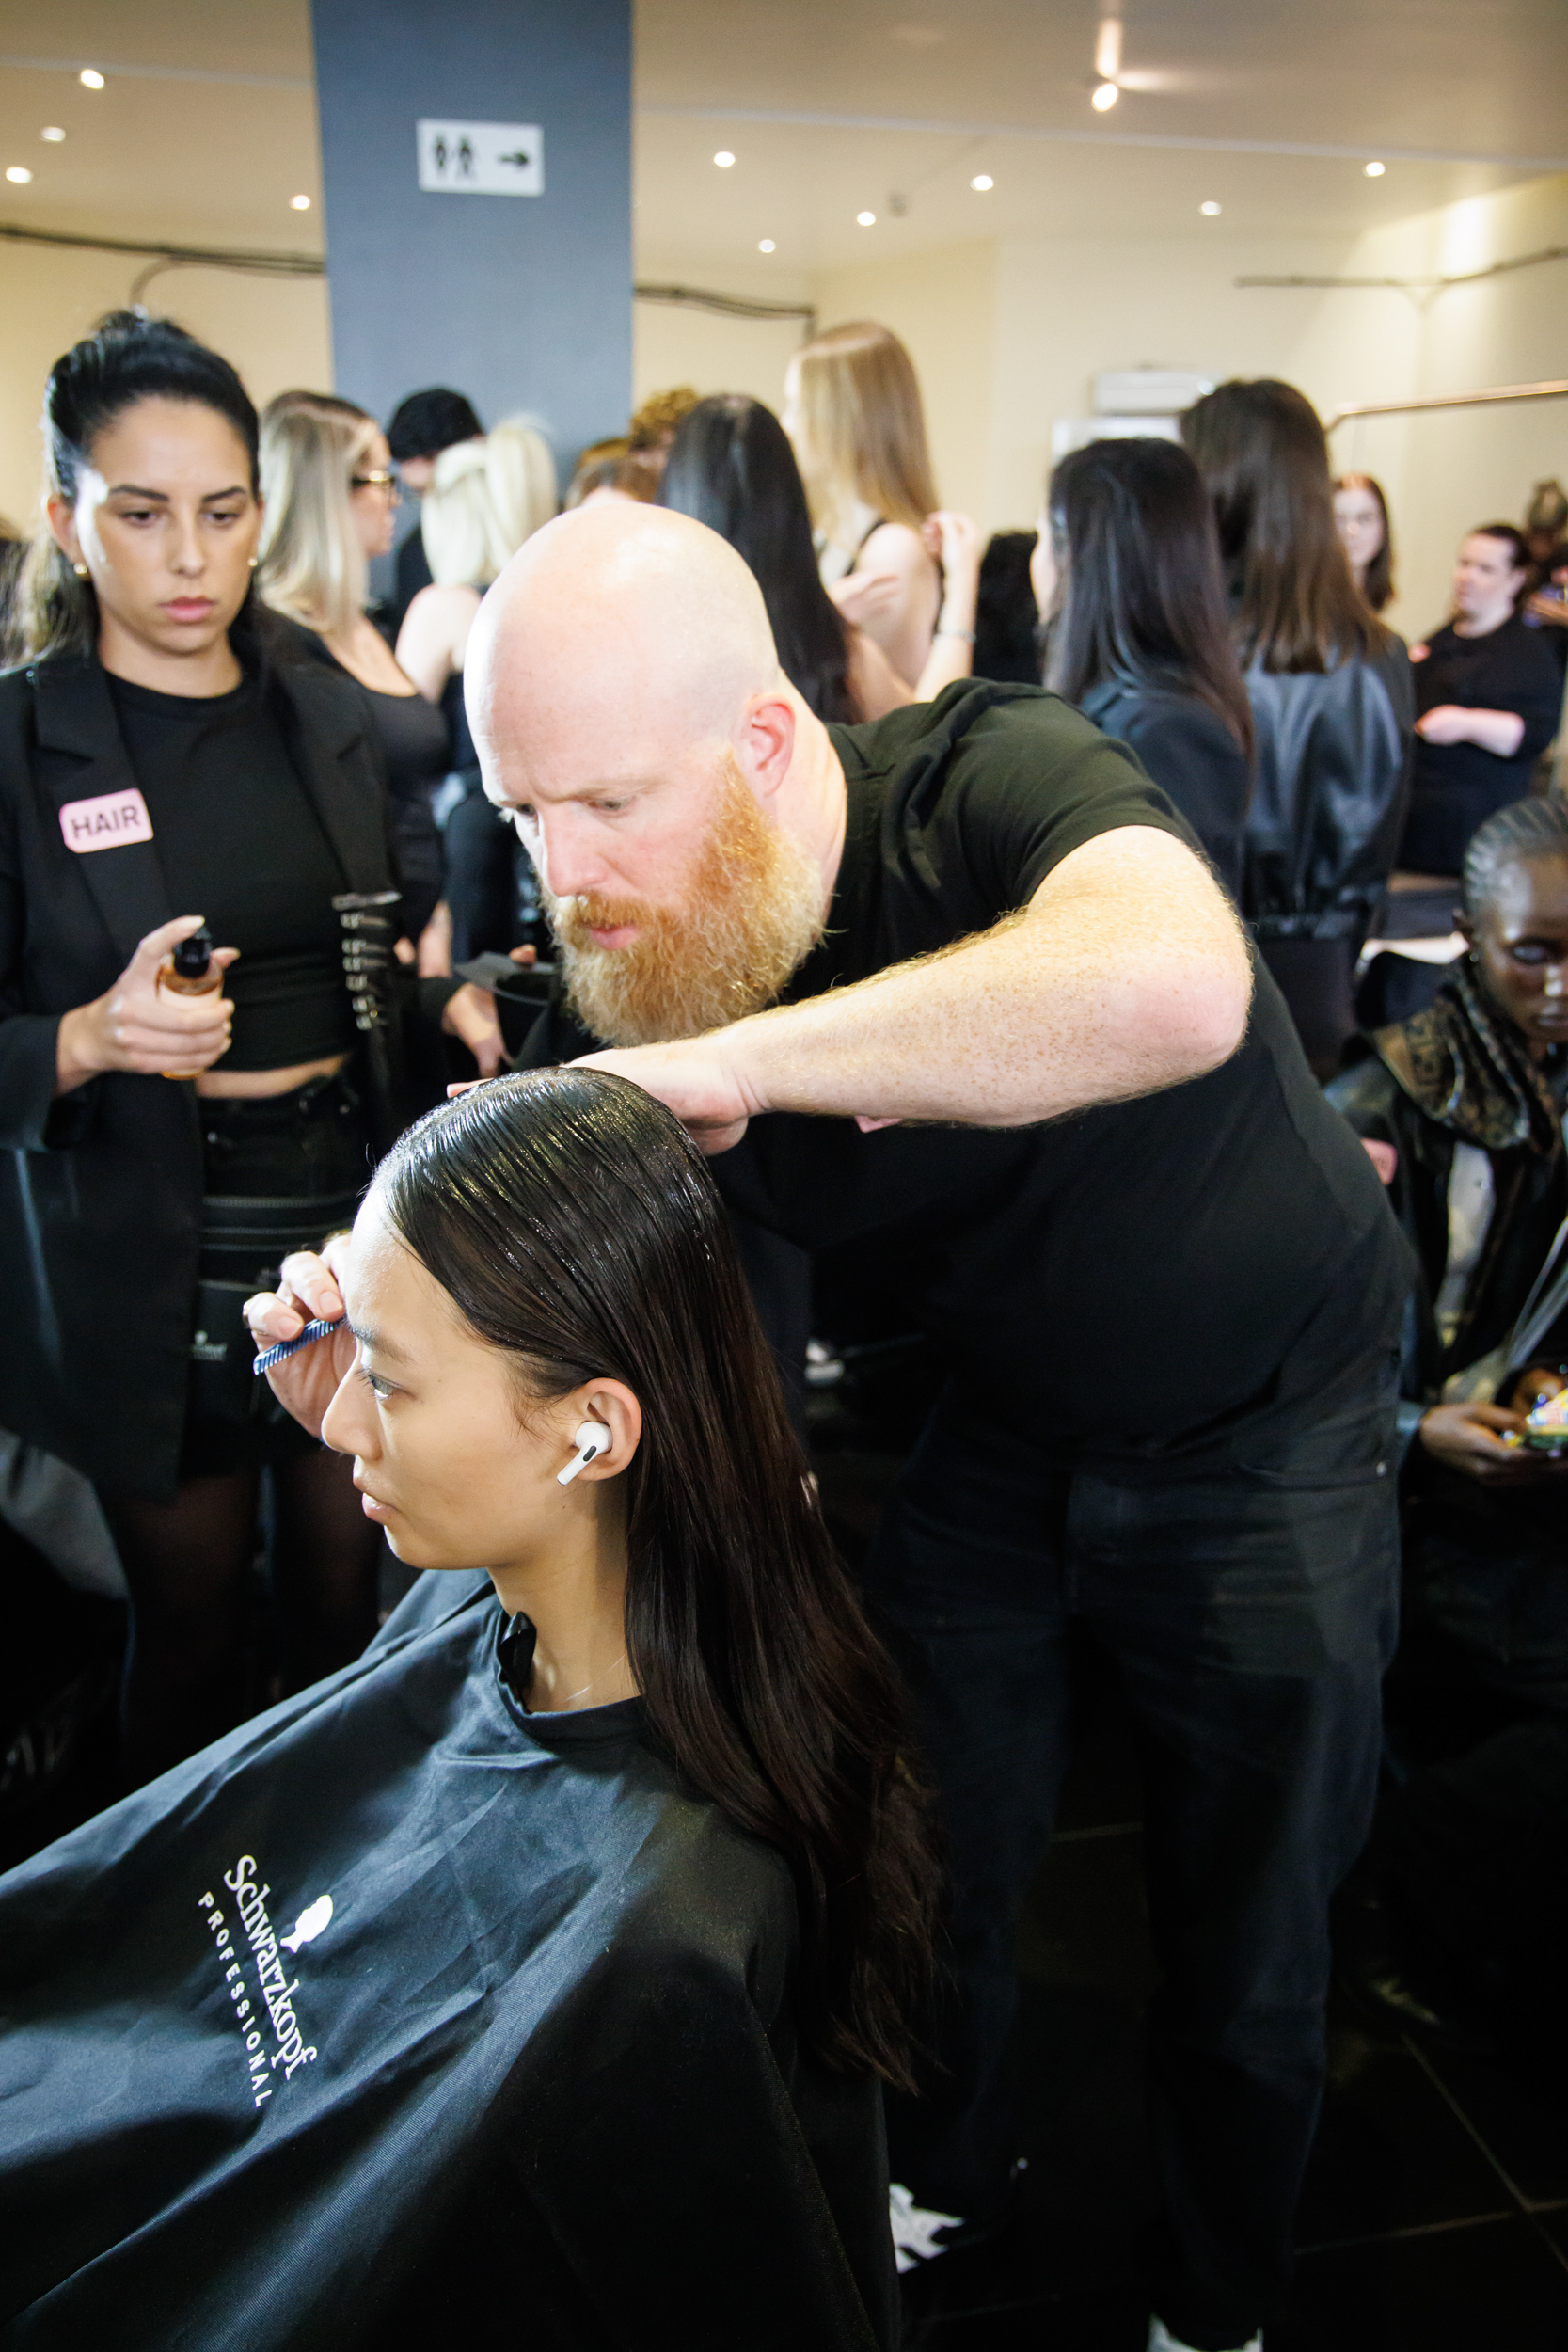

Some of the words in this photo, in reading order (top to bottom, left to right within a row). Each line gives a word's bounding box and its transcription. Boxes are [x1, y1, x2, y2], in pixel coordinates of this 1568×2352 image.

[71, 806, 139, 839] HAIR
[198, 1891, 273, 2107] PROFESSIONAL
[224, 1855, 317, 2080] Schwarzkopf
